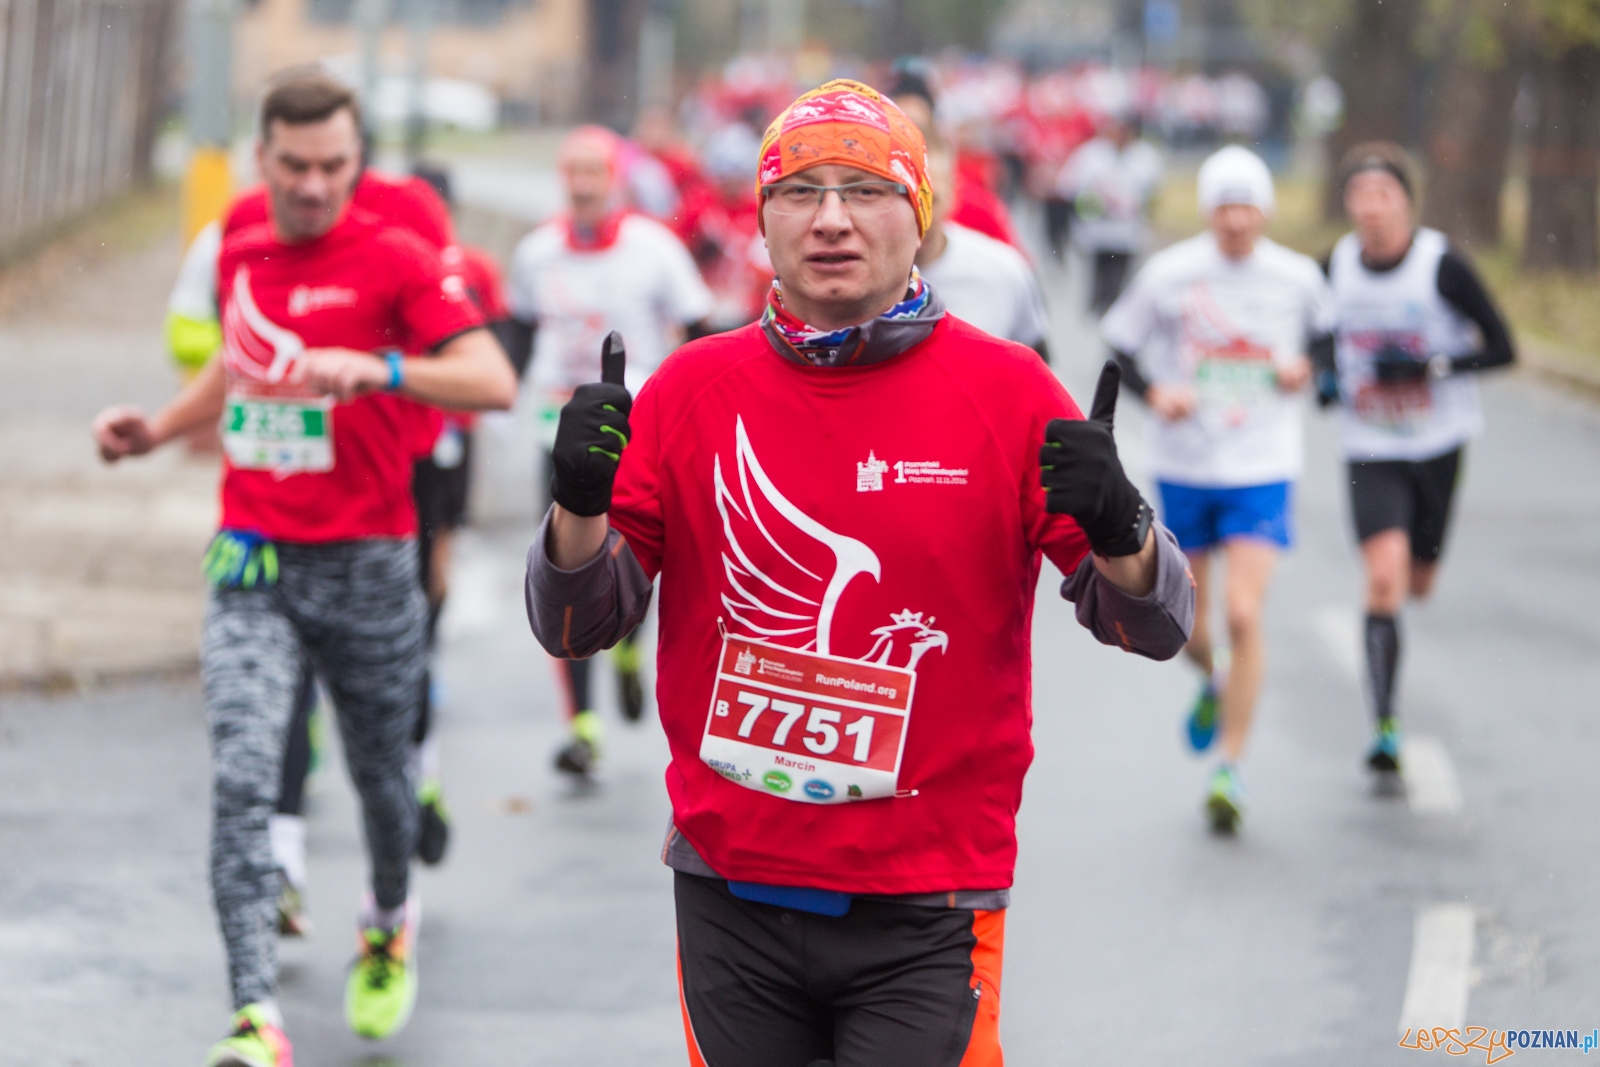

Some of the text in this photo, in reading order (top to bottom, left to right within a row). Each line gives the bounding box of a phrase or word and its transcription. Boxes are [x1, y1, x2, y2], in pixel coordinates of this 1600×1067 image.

[893, 460, 907, 483] 1
[815, 673, 898, 699] RunPoland.org
[715, 690, 876, 763] B 7751
[708, 758, 736, 772] GRUPA
[774, 755, 816, 772] Marcin
